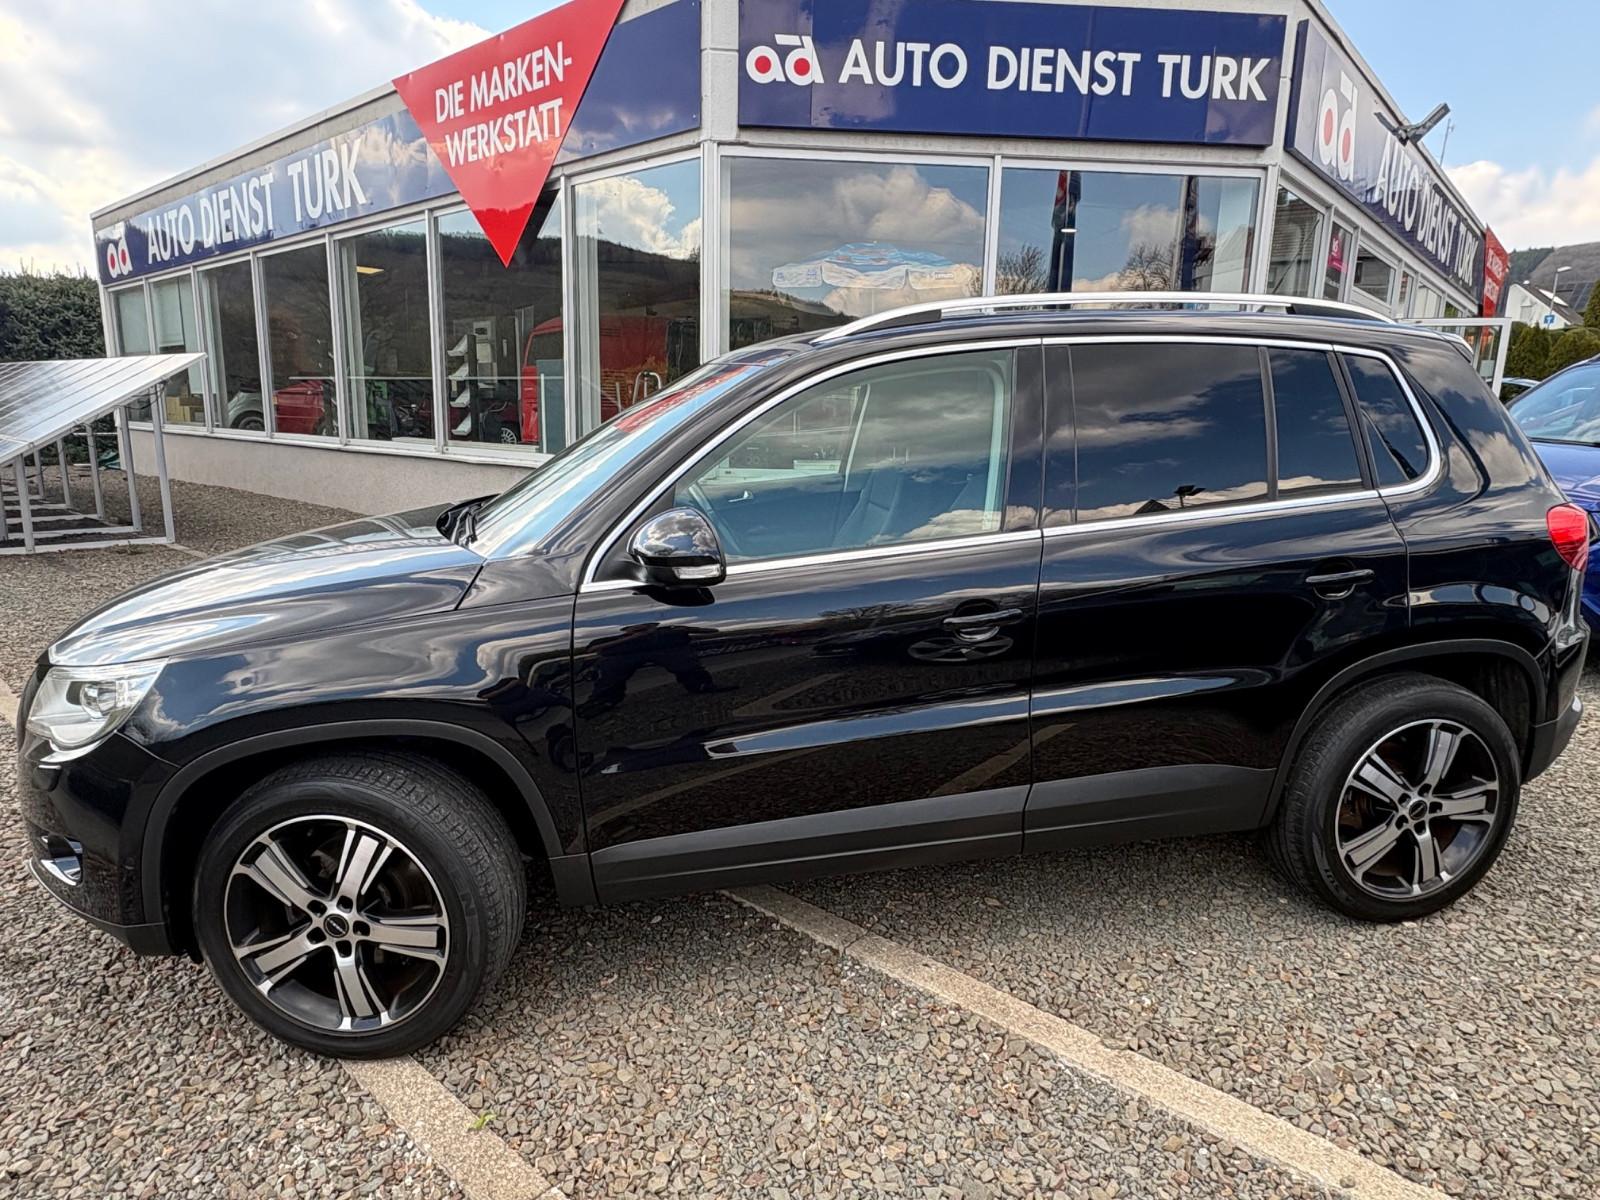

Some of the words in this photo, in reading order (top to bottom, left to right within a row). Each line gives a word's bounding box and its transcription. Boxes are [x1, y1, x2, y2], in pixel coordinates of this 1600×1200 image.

[435, 80, 465, 124] DIE
[470, 41, 573, 113] MARKEN-
[838, 39, 968, 89] AUTO
[987, 45, 1142, 96] DIENST
[1157, 54, 1271, 102] TURK
[444, 97, 564, 168] WERKSTATT
[147, 203, 196, 265] AUTO
[199, 172, 275, 250] DIENST
[287, 137, 368, 223] TURK
[1374, 131, 1419, 232] AUTO
[1416, 179, 1458, 266] DIENST
